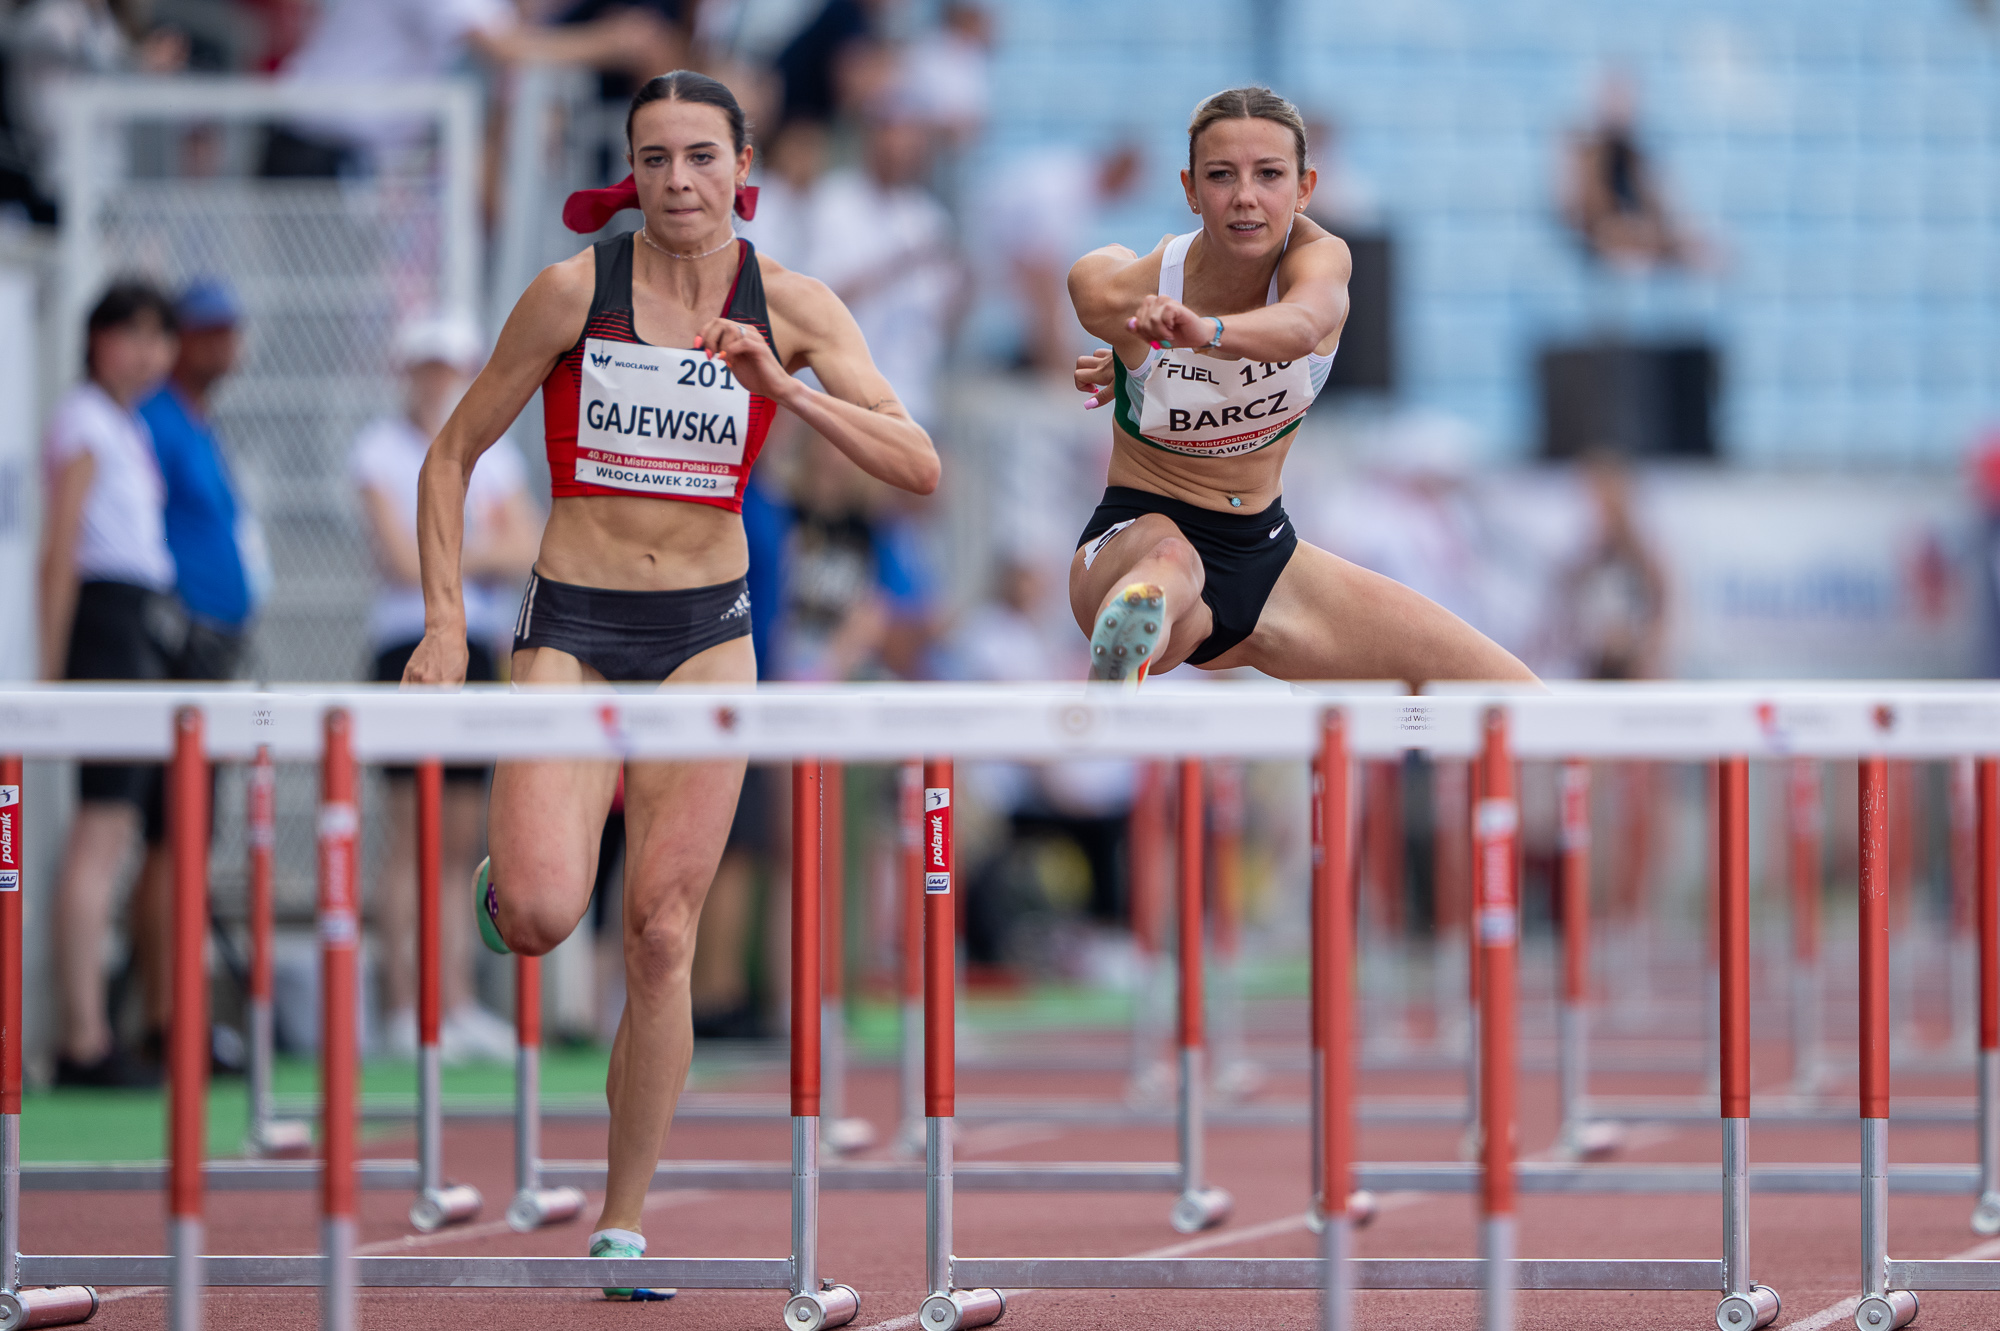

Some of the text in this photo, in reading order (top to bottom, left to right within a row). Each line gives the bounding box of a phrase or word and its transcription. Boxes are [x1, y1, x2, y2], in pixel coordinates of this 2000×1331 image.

[614, 360, 659, 372] WŁOCŁAWEK
[677, 358, 735, 391] 201
[1167, 363, 1220, 385] FUEL
[586, 399, 738, 446] GAJEWSKA
[1169, 389, 1289, 432] BARCZ
[1196, 433, 1255, 447] Mistrzostwa
[1257, 422, 1284, 437] Polski
[587, 450, 730, 474] 40. PZLA Mistrzostwa Polski U23
[596, 466, 717, 489] WŁOCŁAWEK 2023
[0, 812, 14, 864] polanik
[931, 815, 946, 867] polanik
